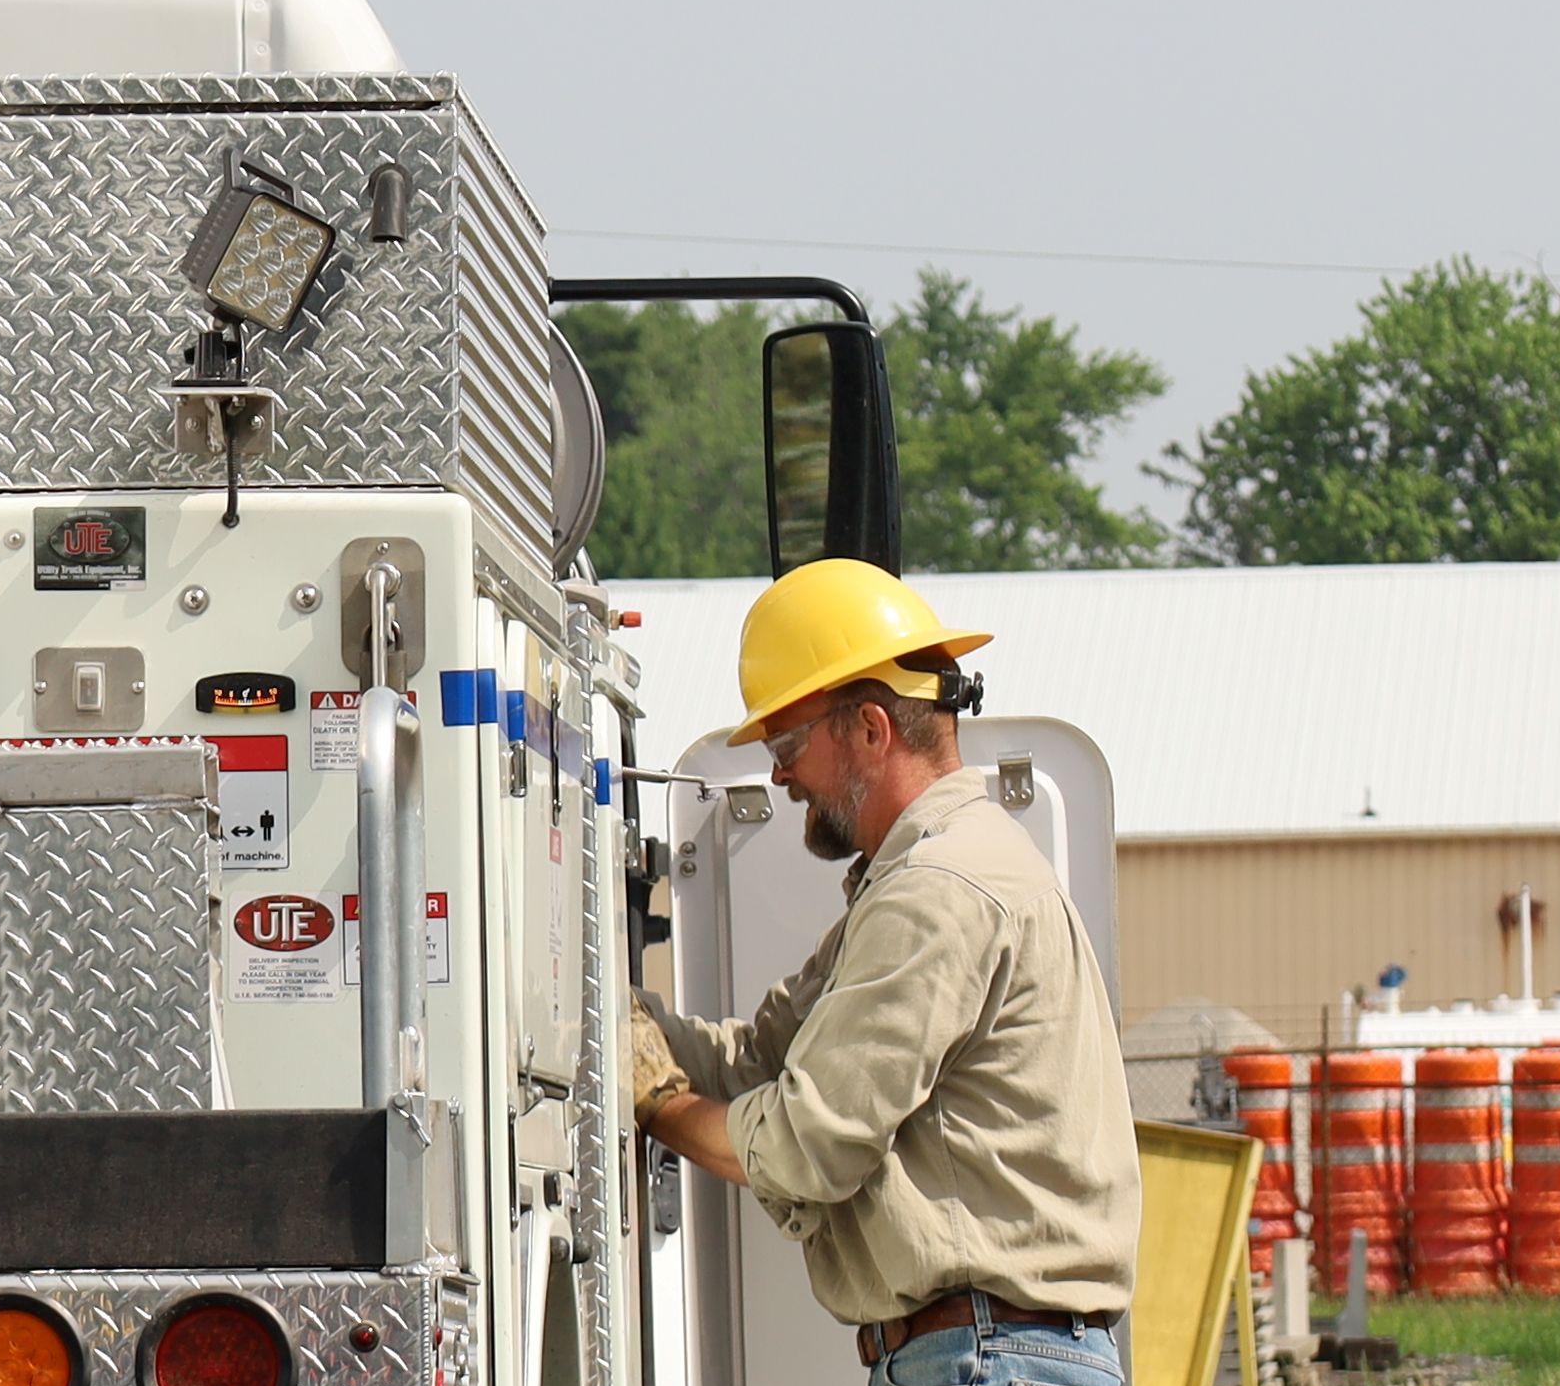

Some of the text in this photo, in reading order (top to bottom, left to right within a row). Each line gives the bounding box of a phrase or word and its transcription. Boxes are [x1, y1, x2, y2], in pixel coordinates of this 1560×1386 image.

[64, 522, 113, 555] UTE
[234, 850, 284, 861] machine.
[253, 902, 317, 942] UTE
